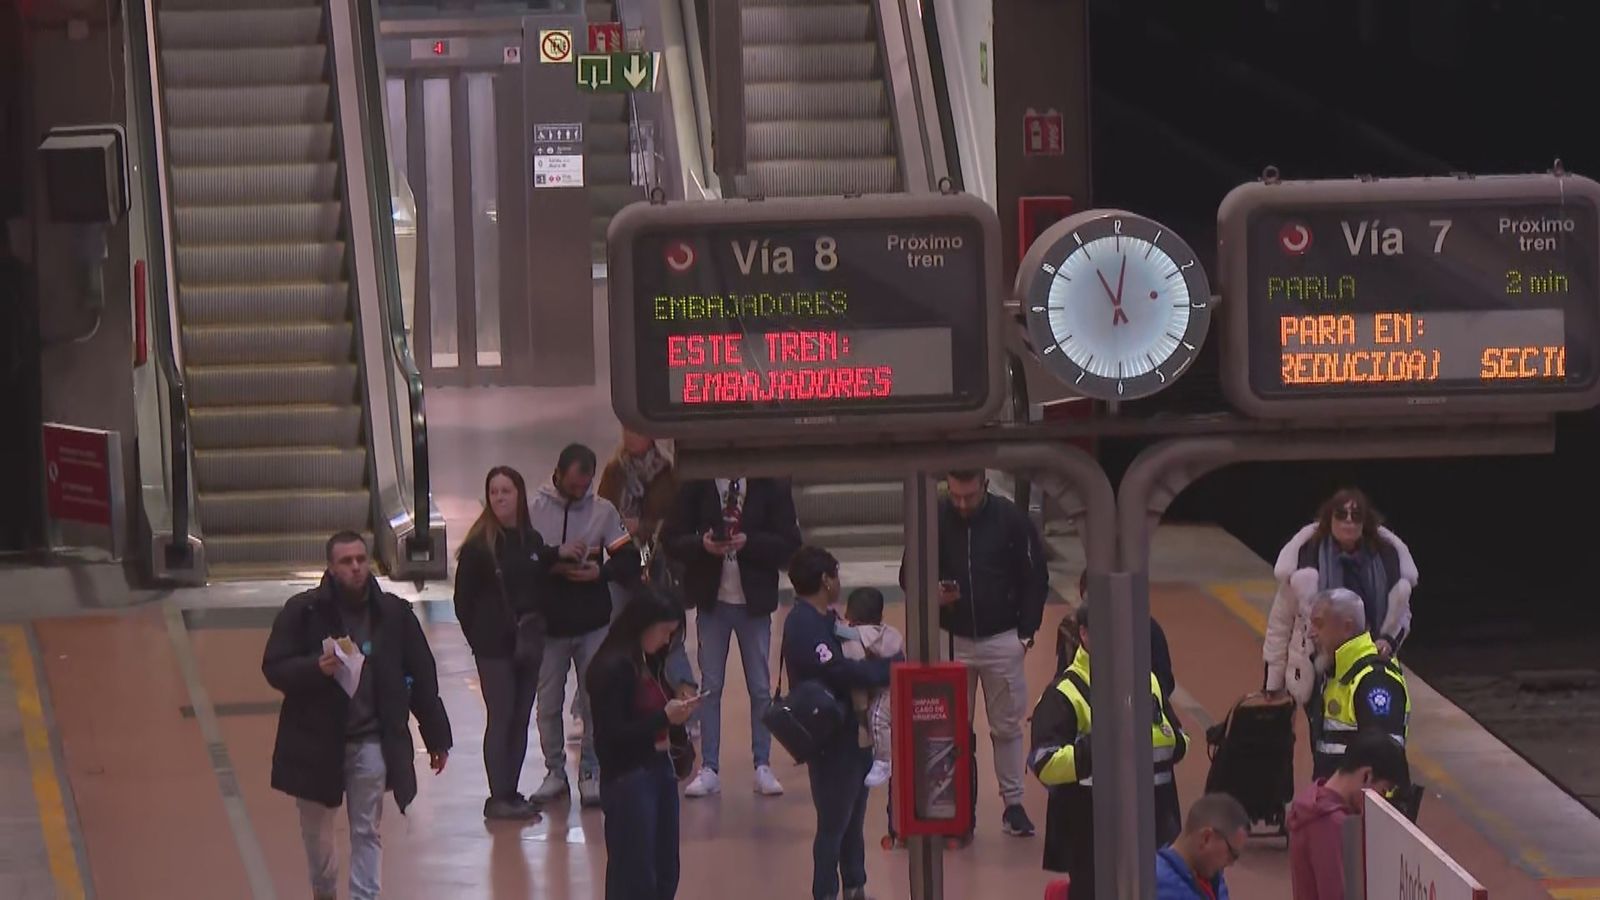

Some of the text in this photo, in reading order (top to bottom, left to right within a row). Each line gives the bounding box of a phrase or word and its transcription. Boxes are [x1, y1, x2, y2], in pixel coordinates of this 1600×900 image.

[1114, 220, 1122, 234] 12
[1341, 219, 1452, 255] Vía 7
[1499, 217, 1576, 234] Próximo
[731, 235, 839, 275] Vía 8
[887, 234, 963, 251] Próximo
[1519, 234, 1556, 252] tren
[907, 251, 945, 268] tren
[1267, 270, 1569, 300] PARLA 2 min
[654, 290, 848, 320] EMBAJADORES
[1281, 312, 1424, 346] PARA EN:
[668, 330, 850, 367] ESTE TREN:
[683, 366, 893, 404] EMBAJADORES
